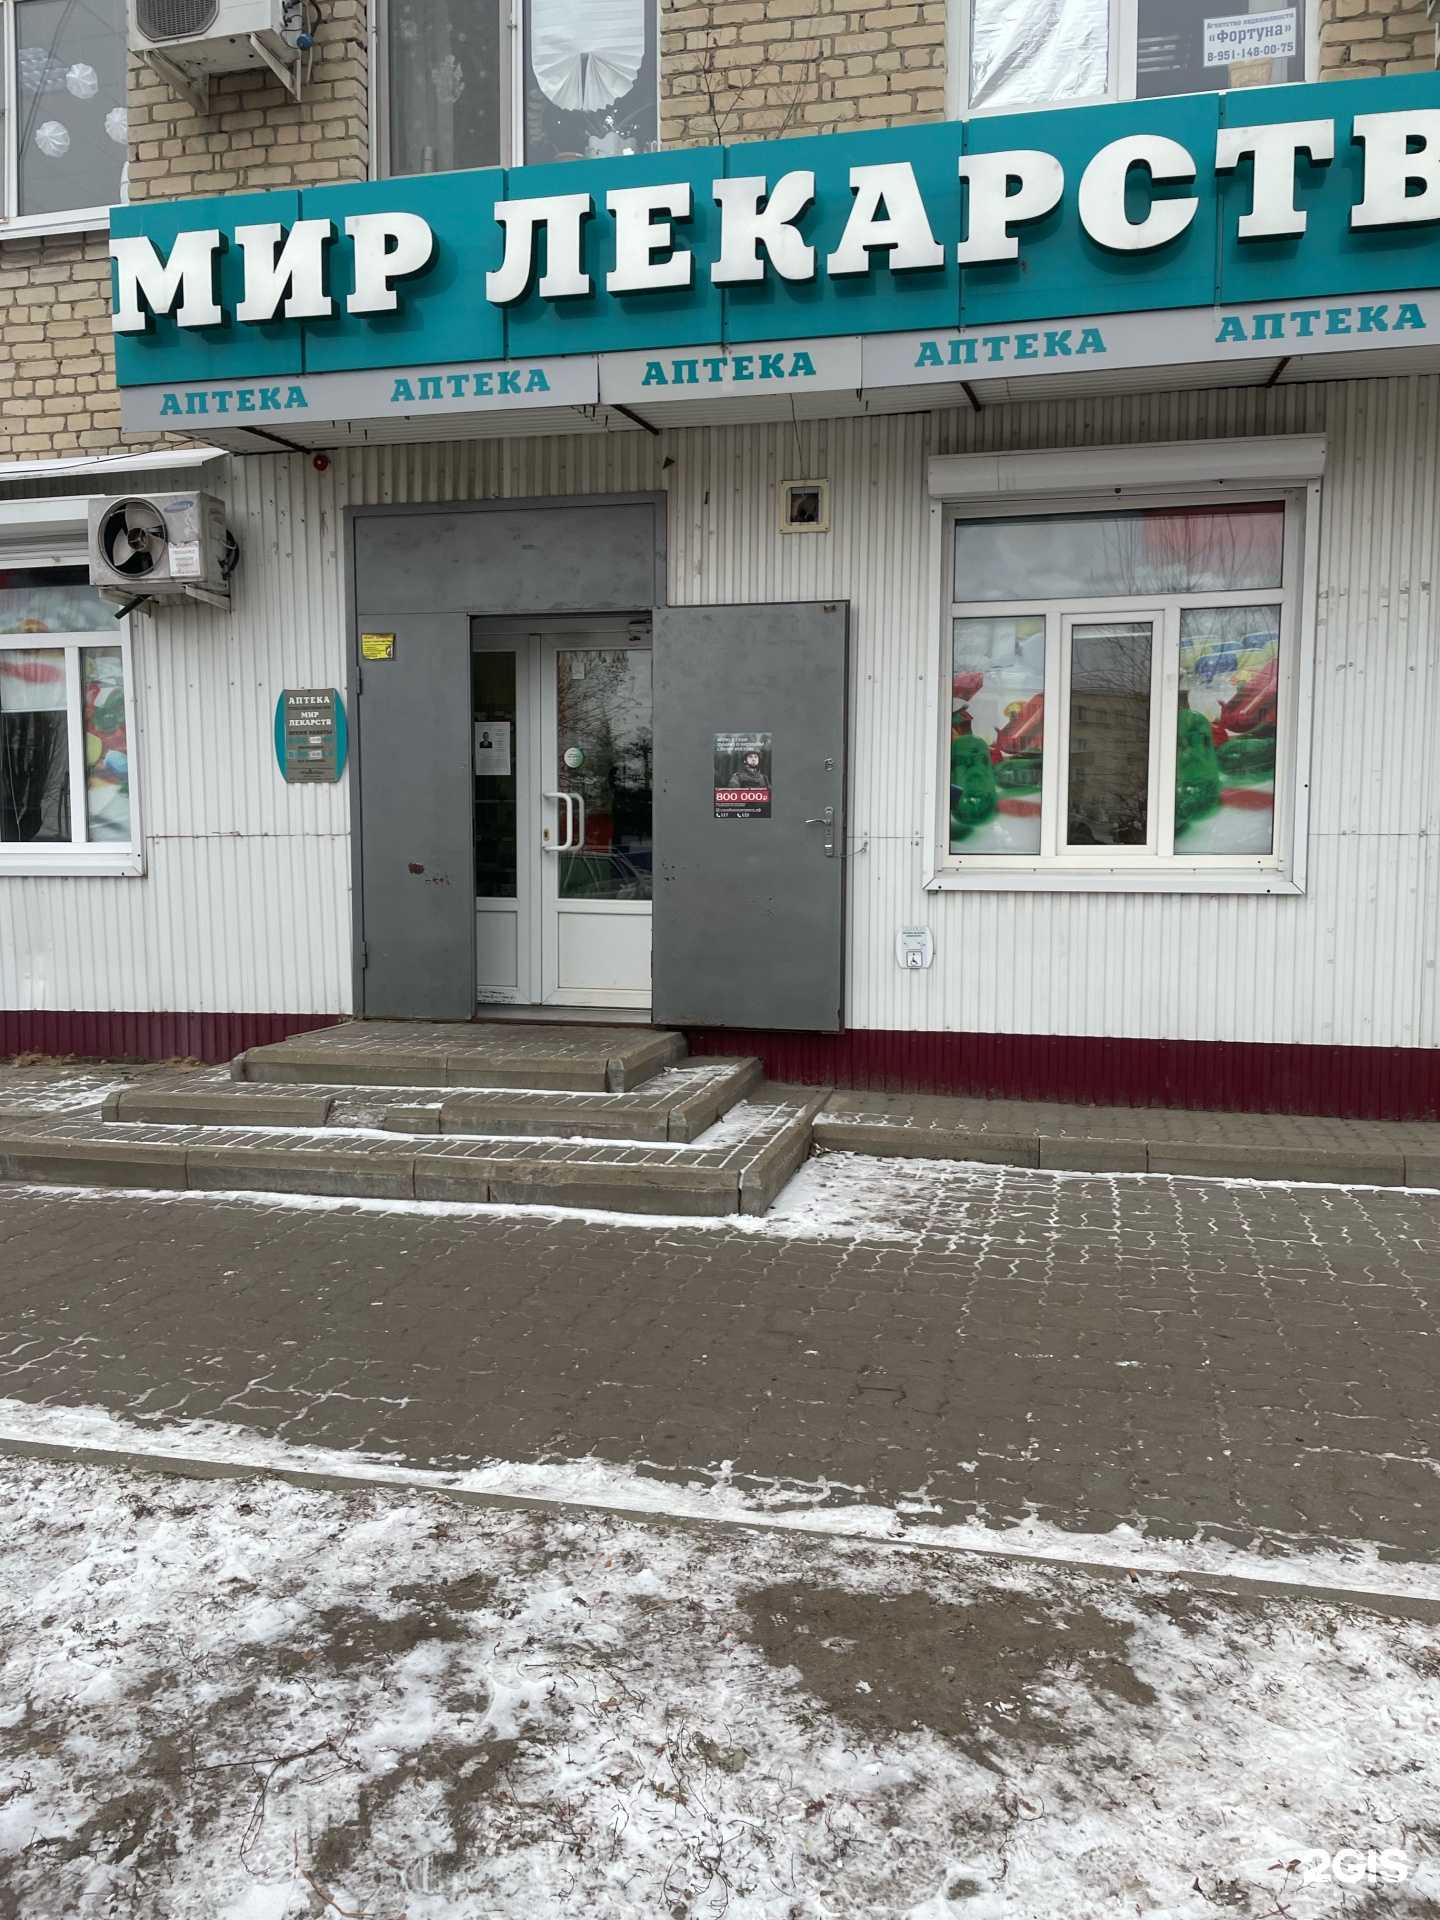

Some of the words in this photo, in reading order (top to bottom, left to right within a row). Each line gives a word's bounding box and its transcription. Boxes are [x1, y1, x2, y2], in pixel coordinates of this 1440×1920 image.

[1207, 41, 1294, 62] 8-951-148-00-75
[110, 212, 433, 334] МИР
[486, 109, 1440, 304] ЛЕКАРСТВ
[1215, 302, 1426, 343] АПТЕКА
[915, 327, 1107, 367] АПТЕКА
[391, 368, 550, 403] АПТЕКА
[642, 352, 816, 386] АПТЕКА
[160, 386, 309, 416] АПТЕКА
[288, 696, 330, 704] АПТЕКА
[716, 792, 738, 801] 800
